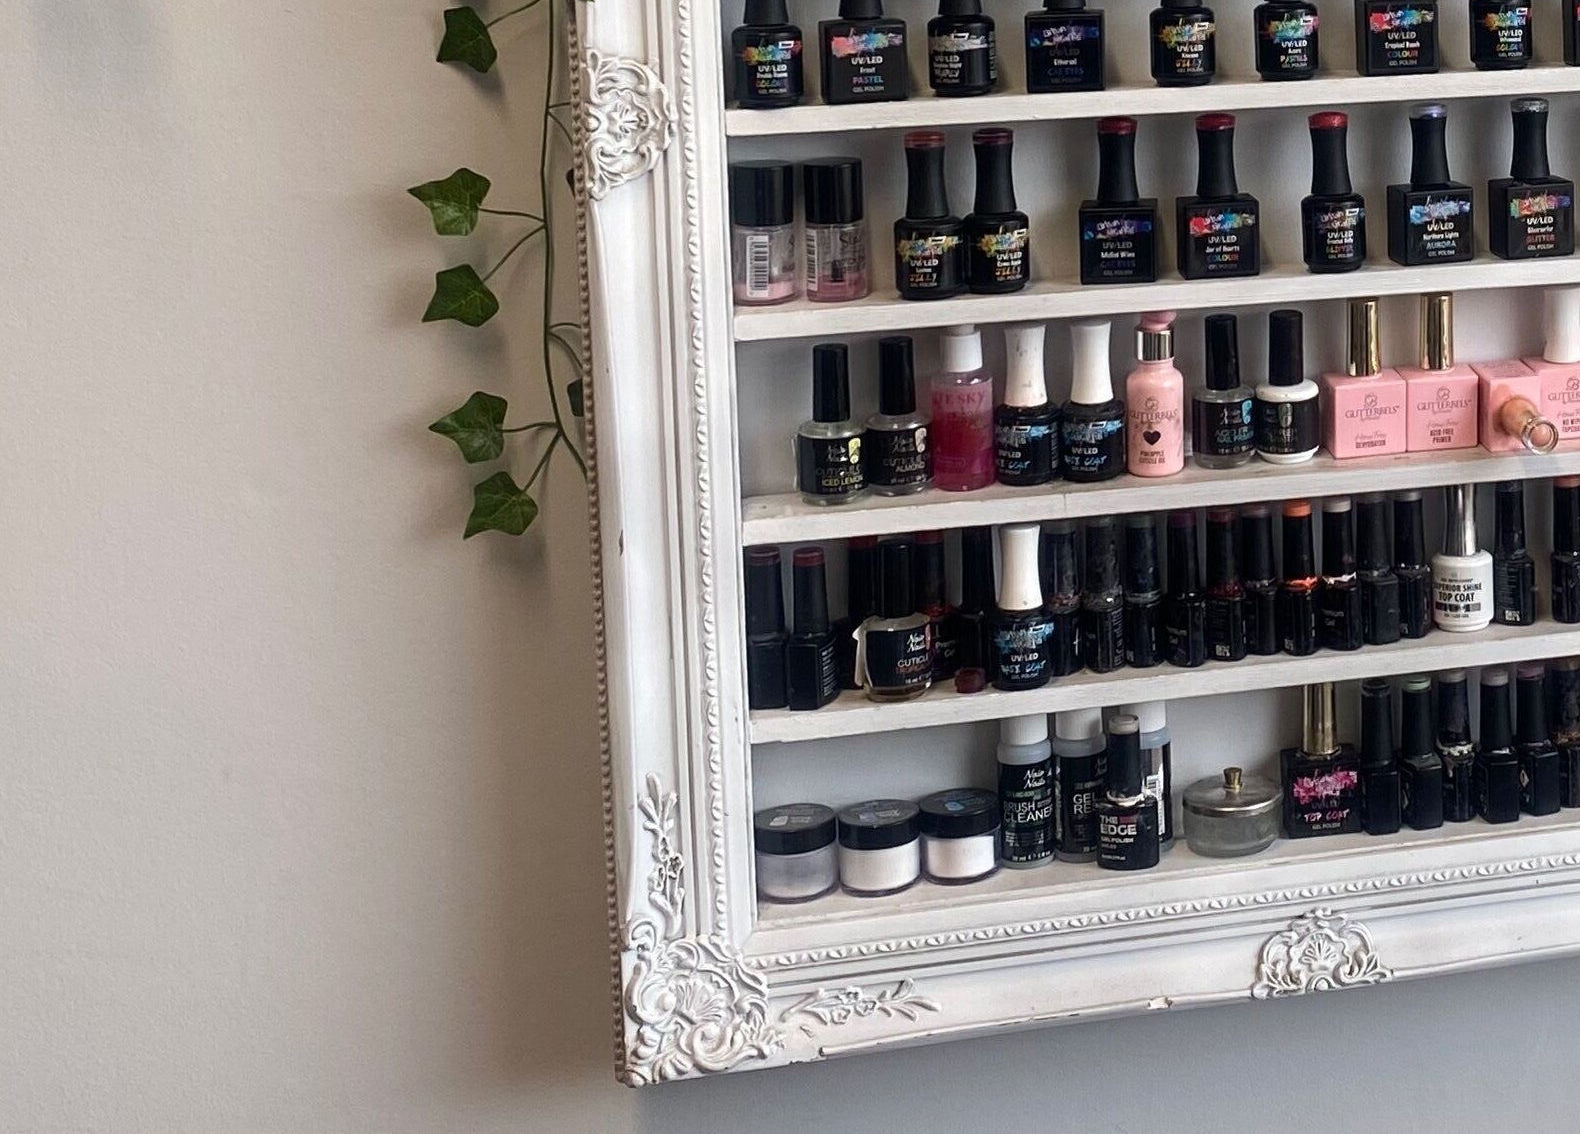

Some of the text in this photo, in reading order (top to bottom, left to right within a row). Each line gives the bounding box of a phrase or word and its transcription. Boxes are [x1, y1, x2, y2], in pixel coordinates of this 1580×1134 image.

[1387, 31, 1416, 40] UV/LED
[852, 75, 884, 84] PASTEL
[1527, 216, 1554, 225] UV/LED
[1426, 241, 1457, 250] AURORA
[1003, 801, 1036, 815] BRUSH
[1100, 824, 1137, 836] EDGE
